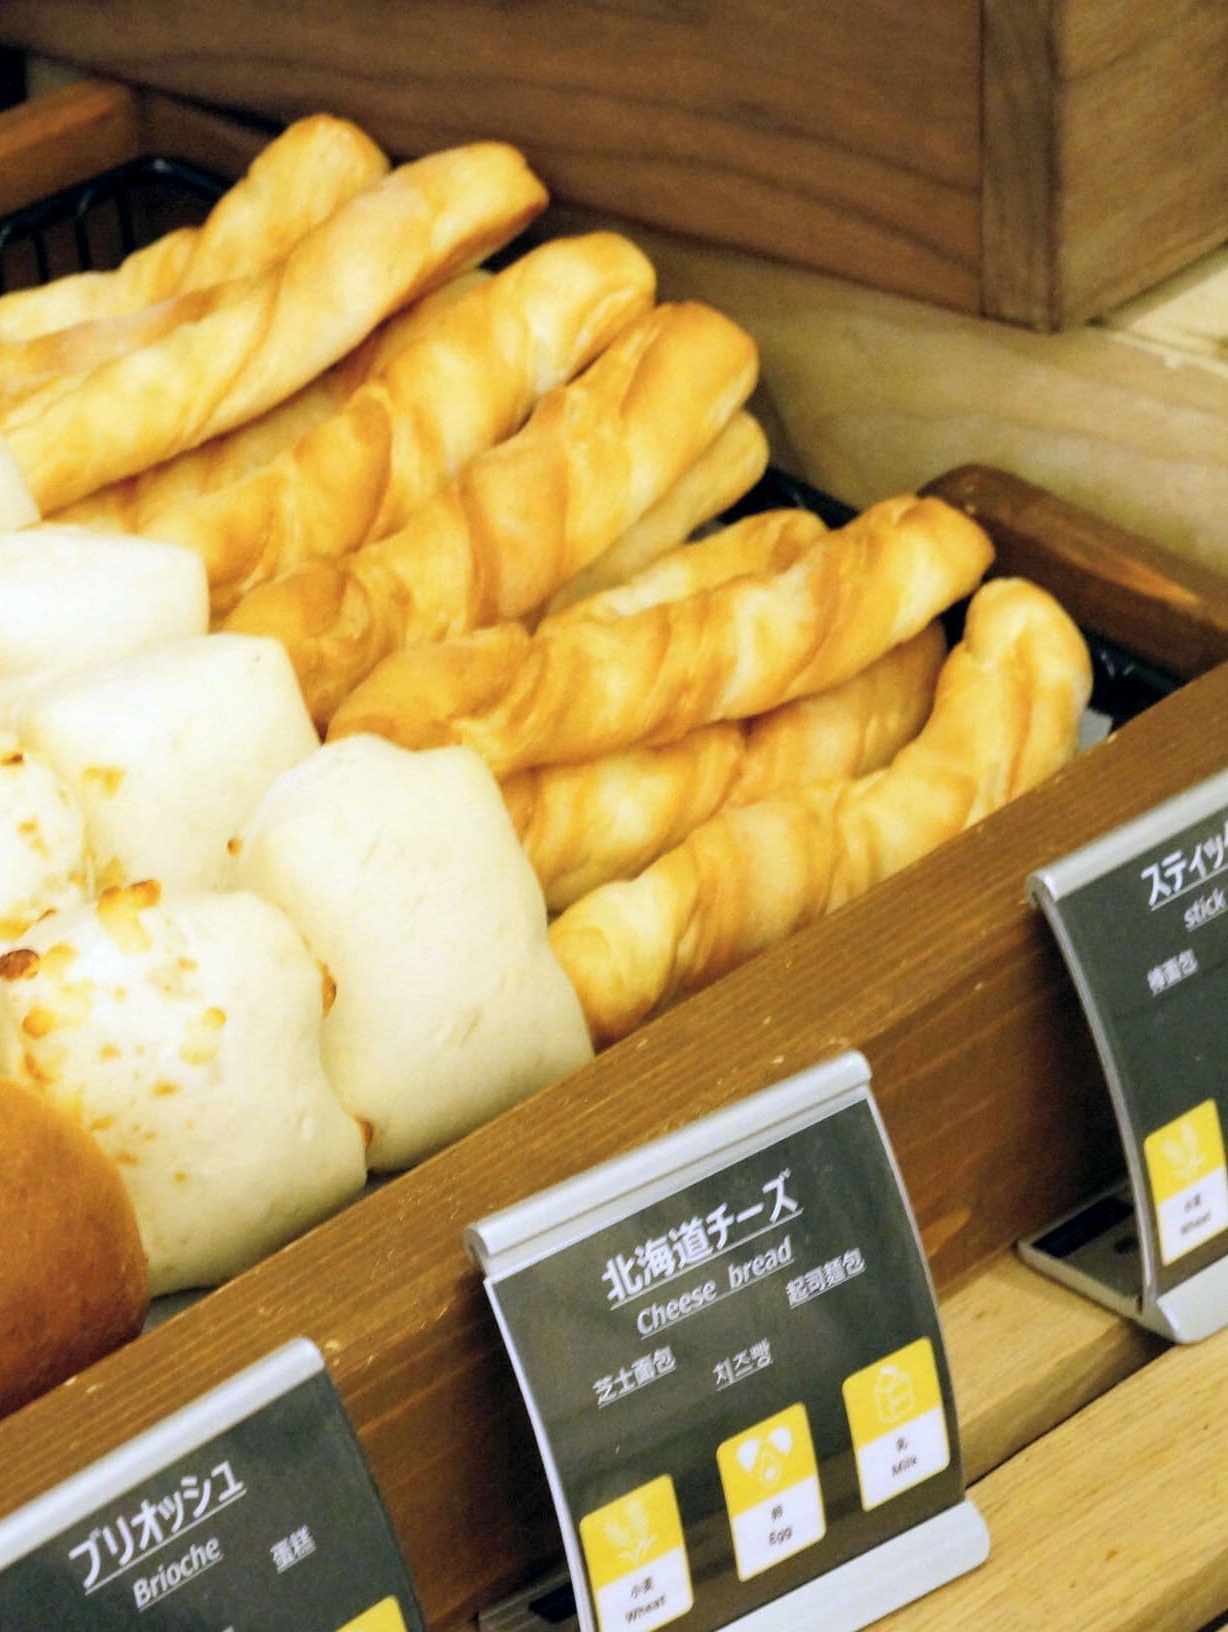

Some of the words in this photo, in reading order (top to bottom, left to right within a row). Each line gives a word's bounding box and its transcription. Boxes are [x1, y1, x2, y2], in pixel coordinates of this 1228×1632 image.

[1141, 822, 1228, 907] スティッ
[601, 1167, 799, 1303] 北海道チーズ
[636, 1279, 717, 1335] Cheese
[728, 1233, 793, 1291] bread
[592, 1345, 675, 1406] 芝士面包
[712, 1337, 773, 1387] 치즈빵
[68, 1460, 245, 1590] ブリオッシュ
[133, 1536, 220, 1610] Brioche
